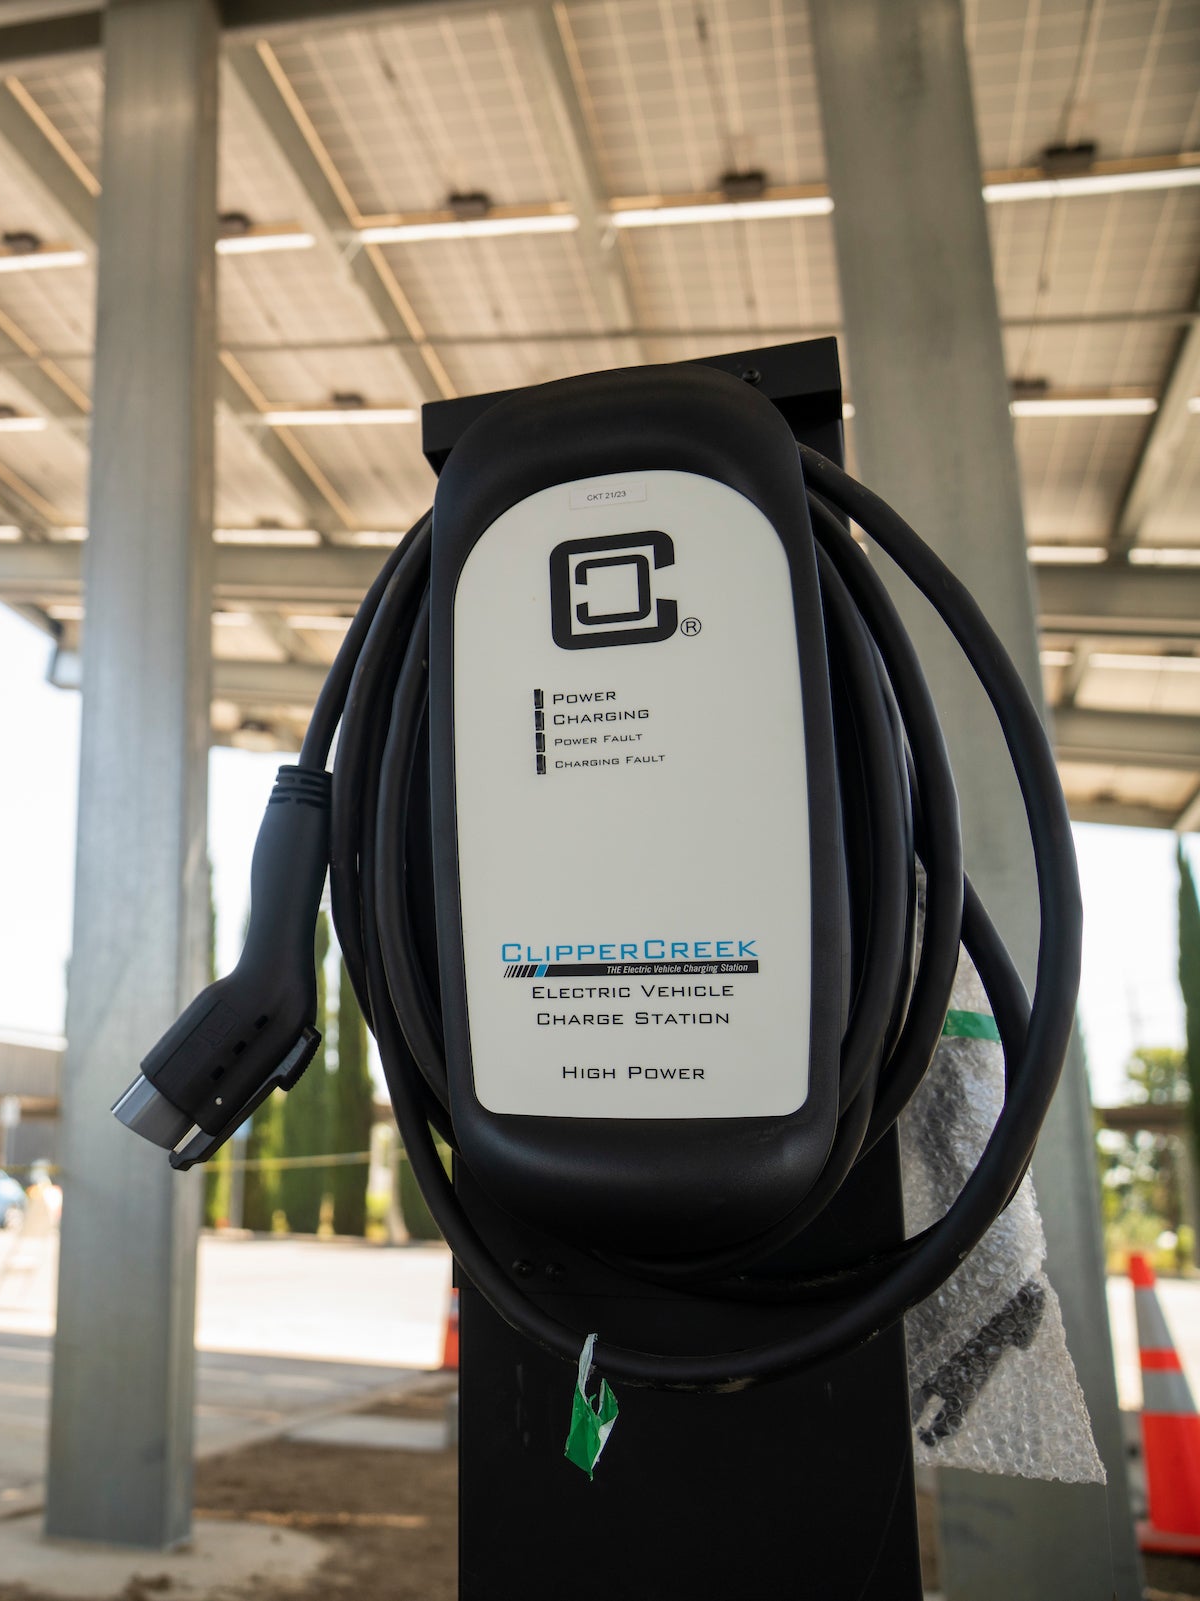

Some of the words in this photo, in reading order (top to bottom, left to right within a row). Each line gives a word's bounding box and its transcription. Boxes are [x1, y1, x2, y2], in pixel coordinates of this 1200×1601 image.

[586, 492, 604, 502] CKT
[605, 490, 627, 500] 21/23
[552, 690, 617, 705] POWER
[553, 709, 650, 726] CHARGING
[554, 736, 598, 747] POWER
[603, 733, 643, 743] FAULT
[554, 757, 620, 769] CHARGING
[625, 754, 666, 764] FAULT
[606, 965, 622, 974] THE
[623, 964, 652, 974] Electric
[653, 963, 682, 973] Vehicle
[683, 963, 719, 975] Charging
[720, 962, 749, 973] Station
[532, 986, 631, 999] ELECTRIC
[641, 984, 734, 998] VEHICLE
[536, 1012, 624, 1026] CHARGE
[635, 1011, 730, 1025] STATION
[562, 1066, 616, 1080] HIGH
[628, 1066, 705, 1080] POWER
